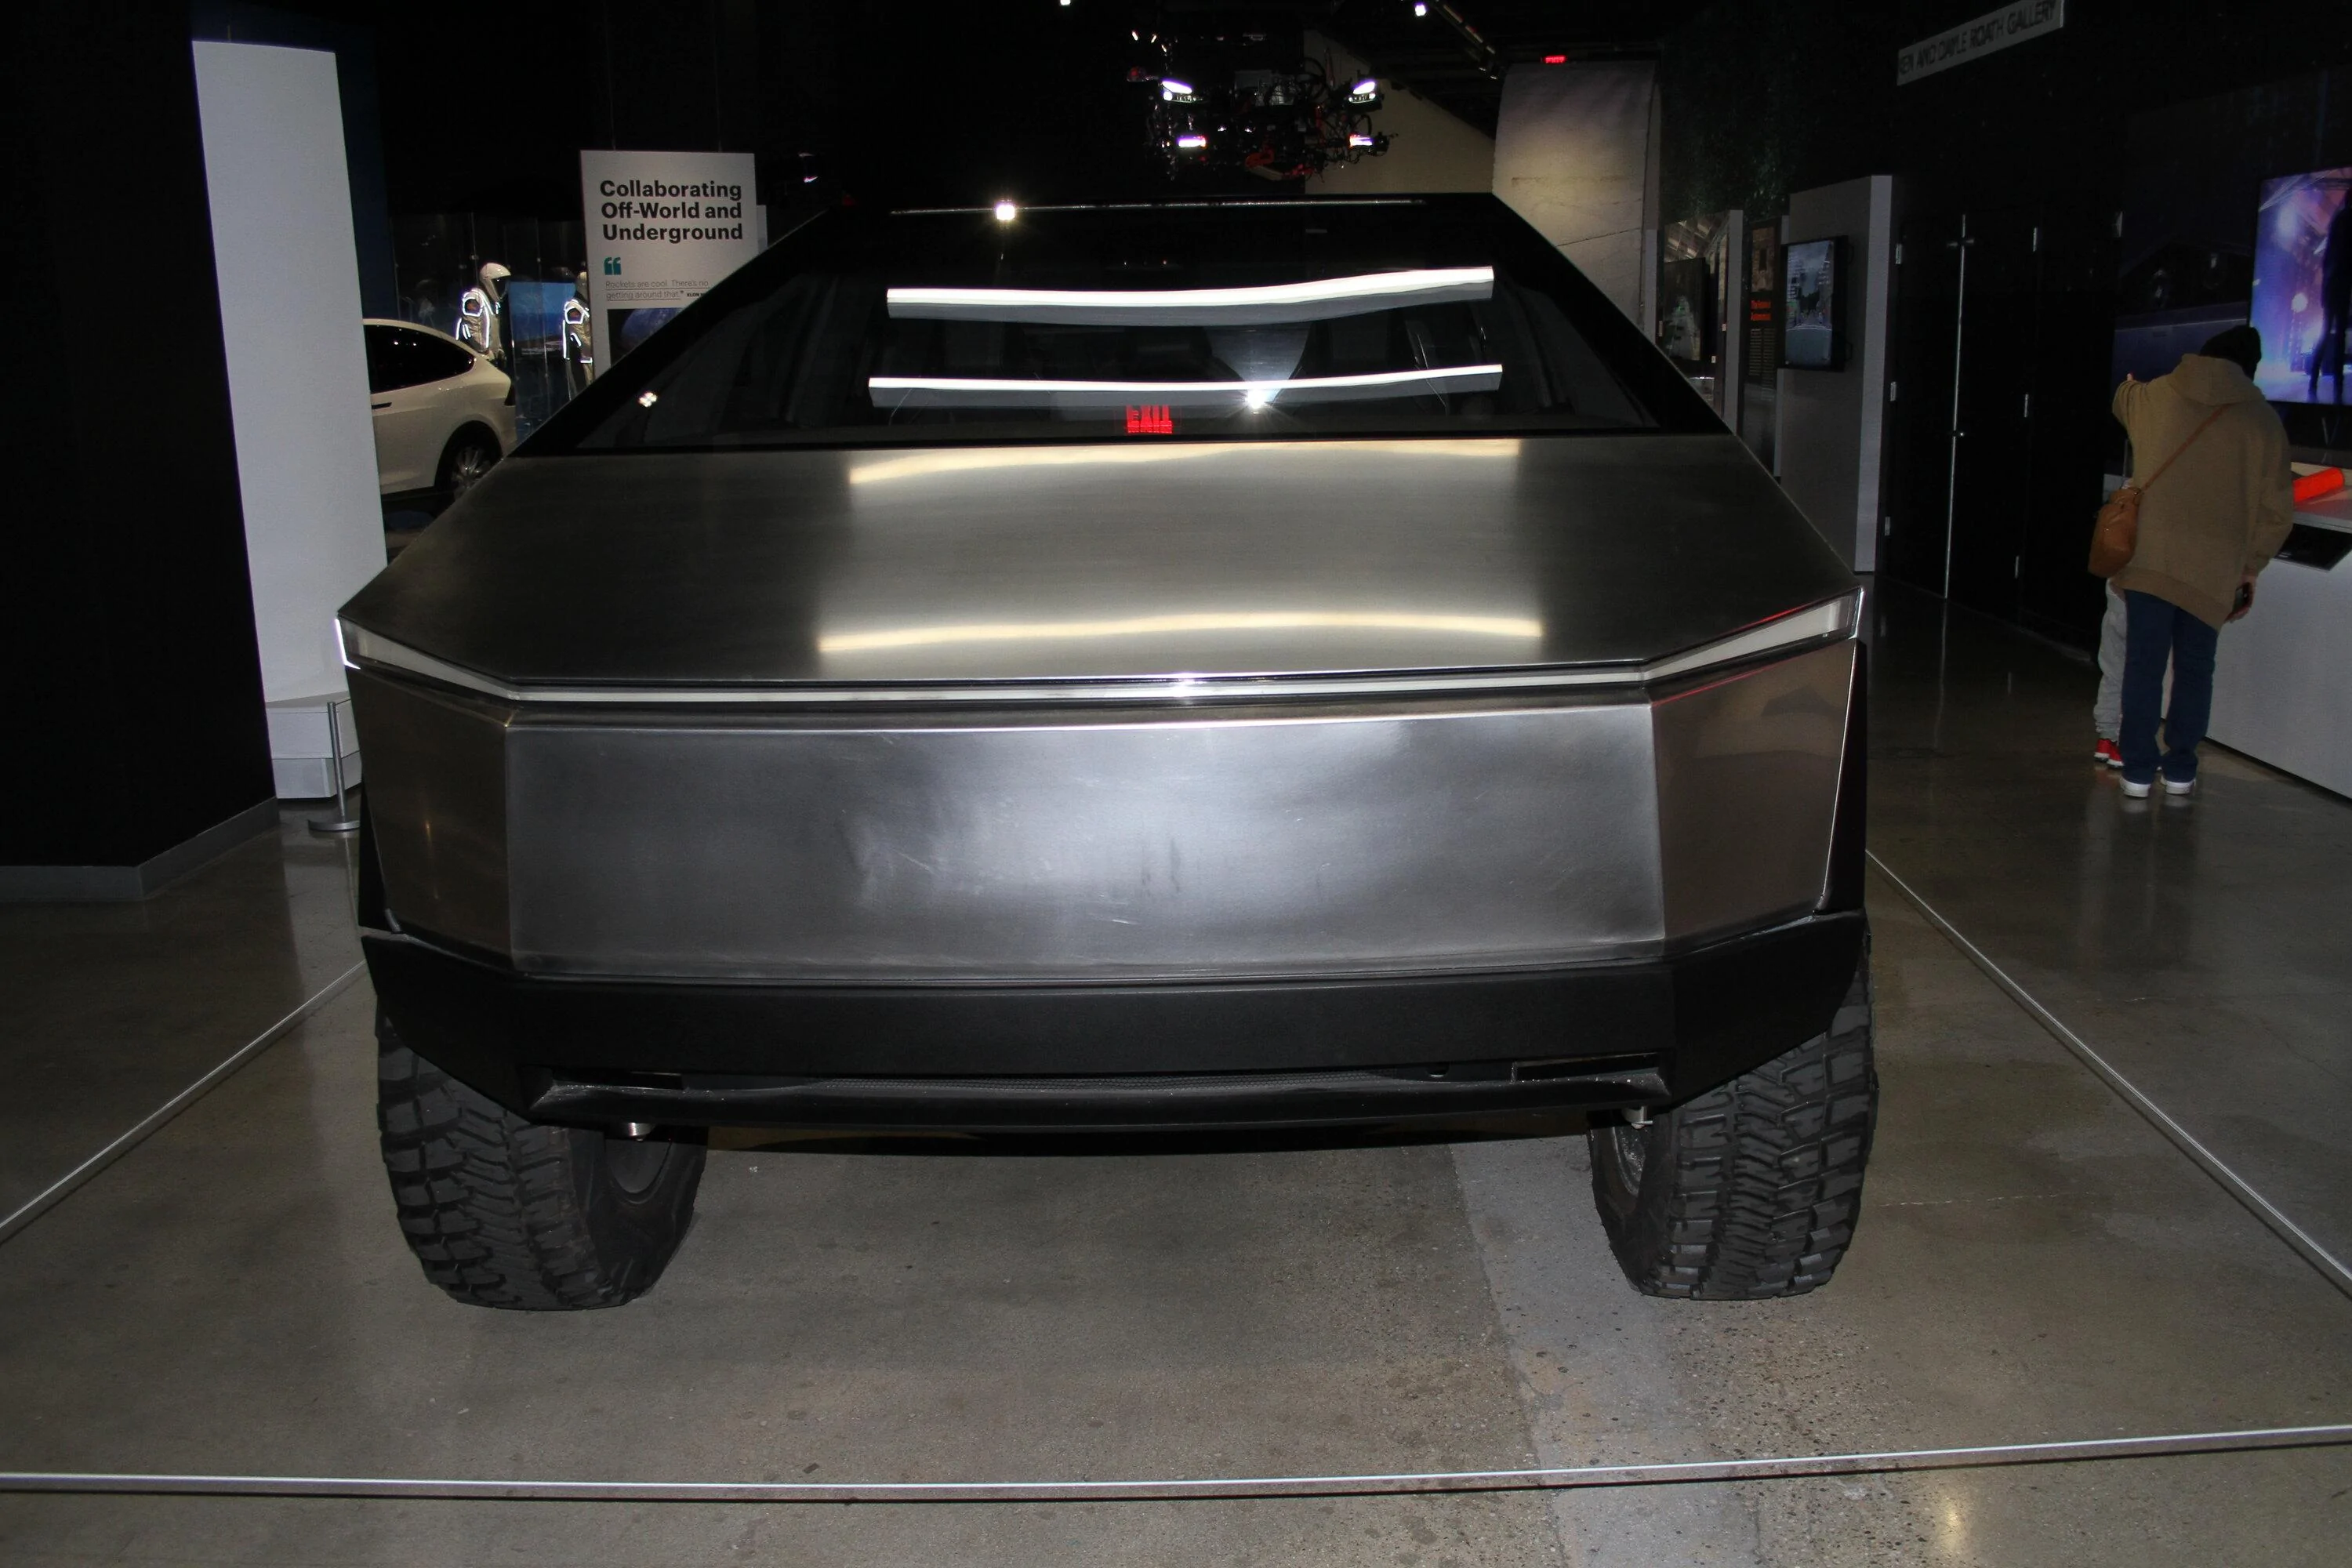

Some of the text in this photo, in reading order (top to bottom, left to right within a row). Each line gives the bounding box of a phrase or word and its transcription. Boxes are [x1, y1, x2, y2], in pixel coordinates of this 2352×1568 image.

[600, 180, 742, 201] Collaborating
[601, 201, 742, 220] Off-World and
[602, 223, 743, 244] Underground
[605, 281, 635, 289] Rockets
[606, 291, 633, 300] getting
[635, 289, 662, 299] around
